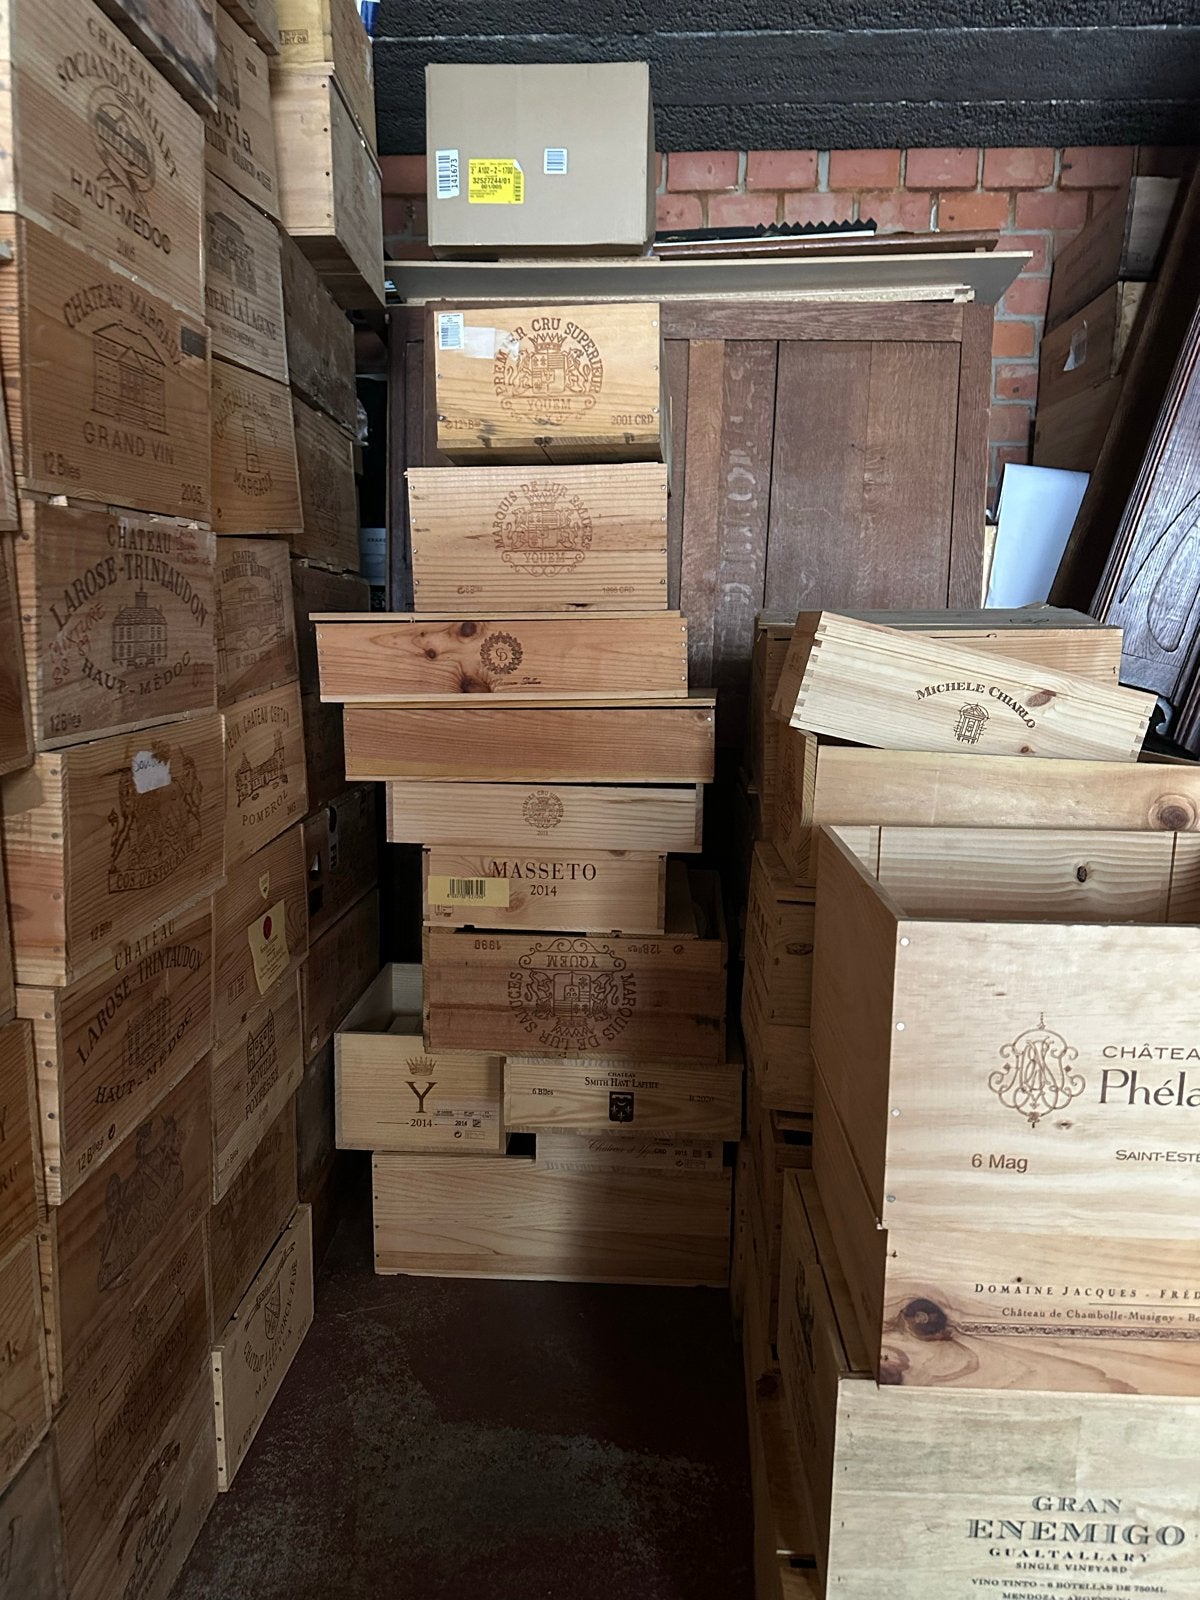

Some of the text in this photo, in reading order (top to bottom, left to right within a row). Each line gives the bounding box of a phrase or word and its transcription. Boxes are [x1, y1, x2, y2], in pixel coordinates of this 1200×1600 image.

[450, 158, 459, 189] 141673
[531, 317, 561, 332] CRU
[564, 321, 604, 394] SUPERIEUR
[635, 414, 654, 425] CRD
[83, 421, 174, 465] GRAND VIN
[491, 491, 518, 550] MARQUIS
[520, 480, 539, 494] DE
[544, 481, 568, 496] LUR
[107, 523, 172, 554] CHATEAU
[522, 551, 566, 564] YQUEM
[50, 552, 209, 632] LAROSE-TRINTAUDON
[916, 681, 1037, 729] MICHELE CHIARLO
[241, 788, 289, 826] POMEROL
[491, 861, 597, 881] MASSETO
[530, 884, 558, 897] 2014
[114, 918, 175, 973] CHATEAU
[474, 938, 502, 950] 1990
[546, 953, 599, 969] YQUEM
[75, 944, 202, 1066] LAROSE-TRINTAUDON
[508, 970, 637, 1051] MARQUIS DE LUR SALUCES
[405, 1081, 438, 1113] Y
[410, 1118, 433, 1129] 2014
[971, 1154, 1028, 1173] 6 Mag
[974, 1283, 1054, 1296] DOMAINE
[1061, 1286, 1138, 1301] JACQUES
[1001, 1307, 1046, 1318] Château
[1050, 1308, 1062, 1318] de
[1066, 1310, 1175, 1325] Chambolle-Musigny
[1031, 1495, 1122, 1514] GRAN
[965, 1518, 1186, 1546] ENEMIGO
[989, 1547, 1151, 1563] GUALTALLARY
[1016, 1562, 1128, 1574] SINGLE VINEYARD
[972, 1578, 999, 1586] VINO
[1002, 1580, 1037, 1588] TINTO
[1056, 1582, 1113, 1591] BOTELLAS
[1116, 1584, 1131, 1592] DE
[1002, 1592, 1056, 1600] MENDOZA
